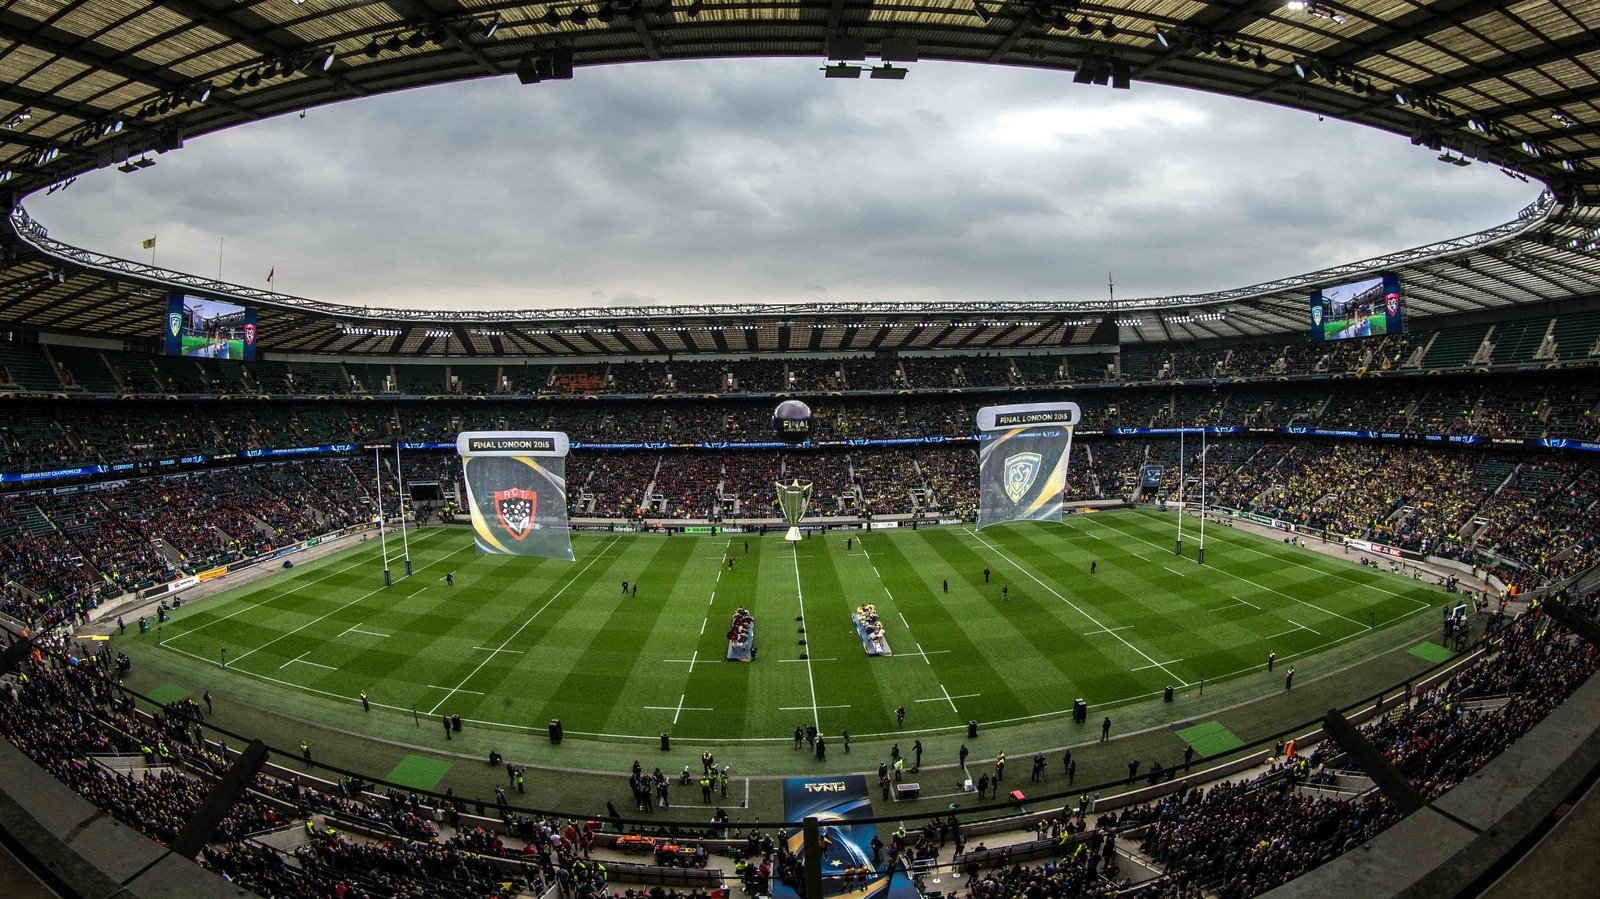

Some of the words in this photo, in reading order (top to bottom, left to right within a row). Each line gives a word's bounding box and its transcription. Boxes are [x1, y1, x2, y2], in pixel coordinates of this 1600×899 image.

[1000, 415, 1021, 424] FINAL
[1023, 414, 1053, 422] LONDON
[783, 420, 810, 429] FINAL
[473, 440, 496, 449] FINAL
[498, 440, 532, 449] LONDON
[533, 440, 550, 449] 2015
[503, 487, 526, 499] RCT
[808, 782, 846, 793] FINAL
